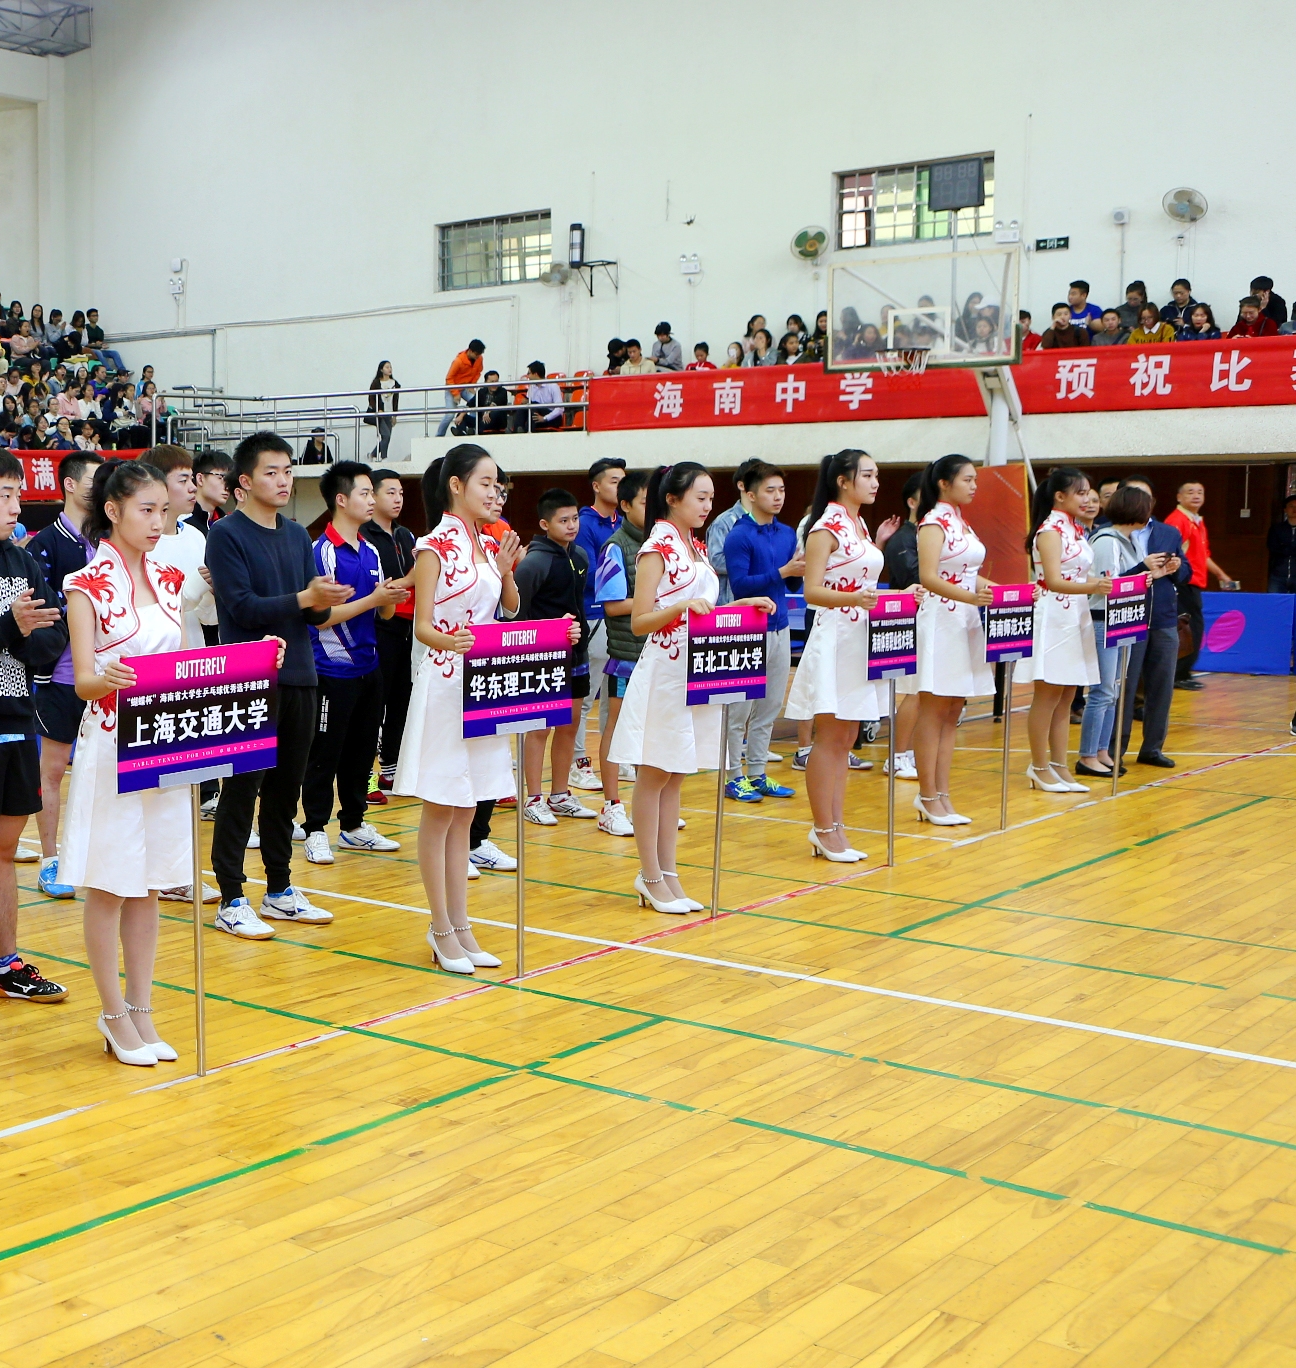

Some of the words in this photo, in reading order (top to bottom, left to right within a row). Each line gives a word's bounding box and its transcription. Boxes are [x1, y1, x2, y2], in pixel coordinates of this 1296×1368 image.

[1055, 349, 1296, 400] 预祝比
[653, 372, 874, 418] 海南中学
[715, 613, 742, 629] BUTTERFLY
[988, 616, 1032, 639] 海南师范大学
[501, 629, 538, 647] BUTTERFLY
[175, 656, 227, 680] BUTTERFLY
[692, 646, 763, 674] 西北工业大学
[469, 666, 566, 702] 华东理工大学
[127, 697, 269, 748] 上海交通大学
[132, 759, 155, 769] TABLE
